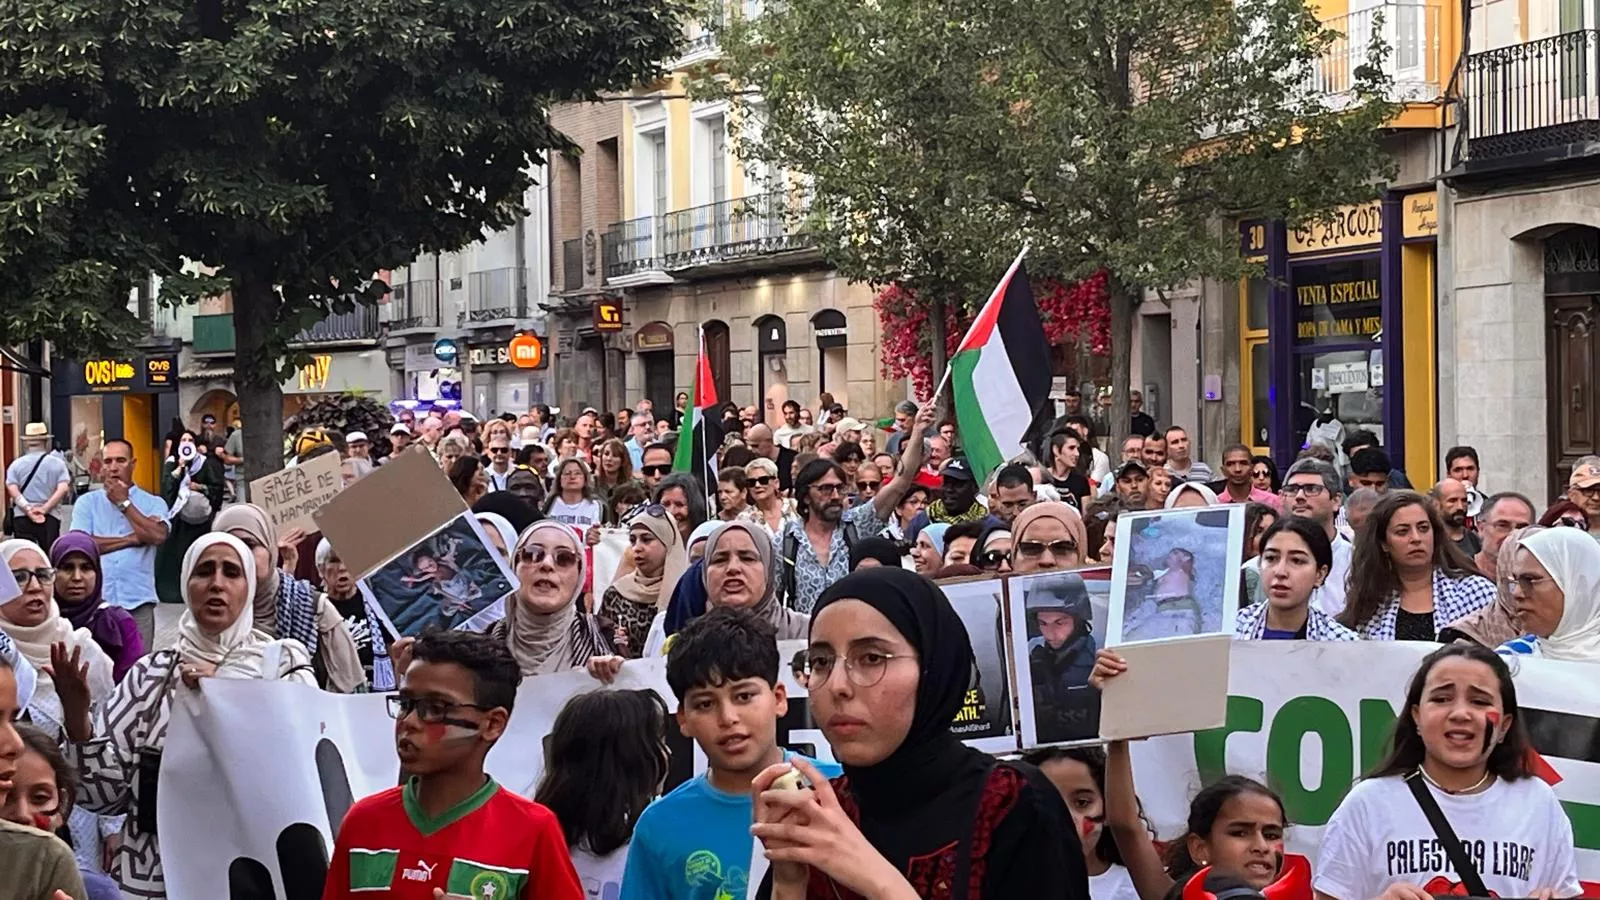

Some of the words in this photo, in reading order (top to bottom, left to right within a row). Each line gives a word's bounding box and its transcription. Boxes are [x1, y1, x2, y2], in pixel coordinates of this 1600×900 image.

[1249, 225, 1265, 250] 30
[1297, 285, 1327, 305] VENTA
[1330, 280, 1379, 303] ESPECIAL
[1297, 322, 1316, 338] ROPA
[1330, 319, 1353, 336] CAMA
[85, 361, 111, 384] OVS
[148, 360, 170, 371] OVS
[262, 468, 305, 494] GAZA
[264, 480, 312, 510] MUERE
[317, 471, 333, 488] DE
